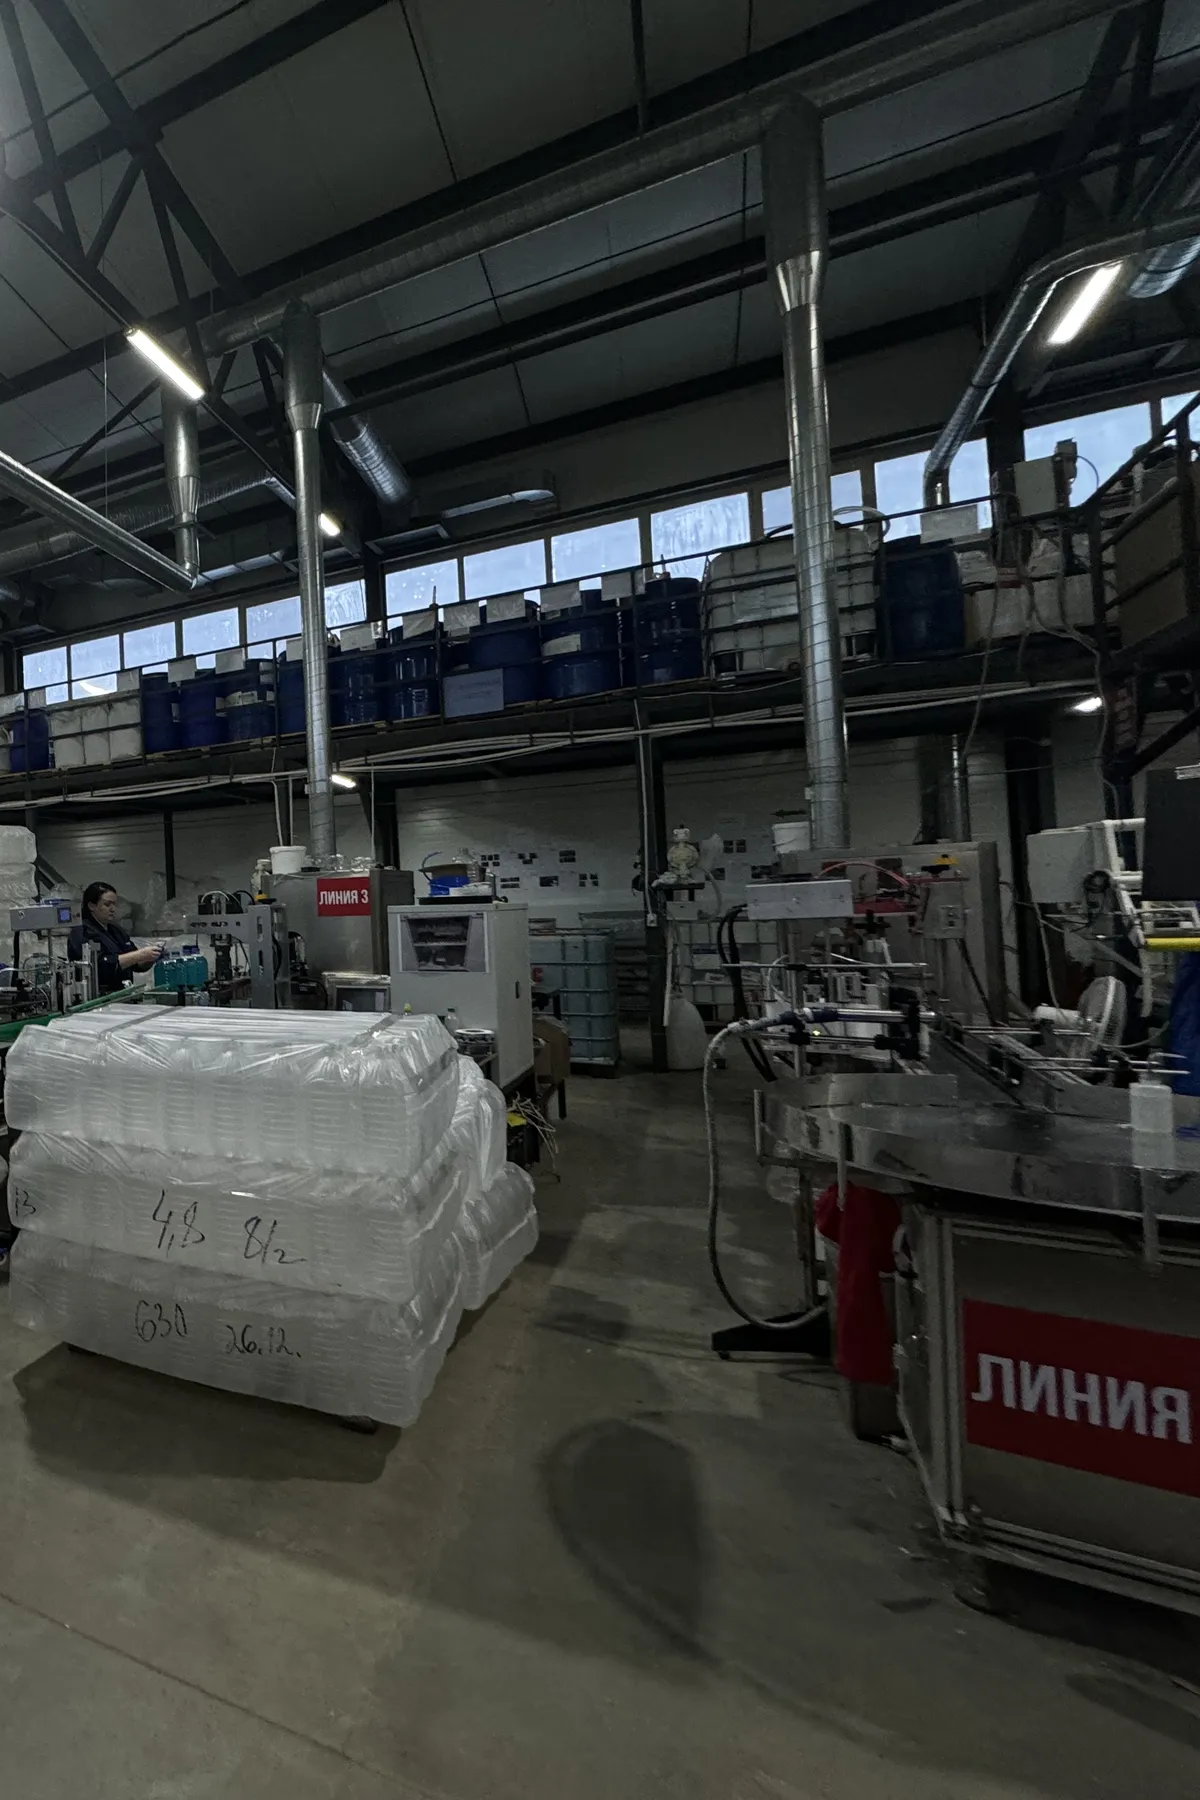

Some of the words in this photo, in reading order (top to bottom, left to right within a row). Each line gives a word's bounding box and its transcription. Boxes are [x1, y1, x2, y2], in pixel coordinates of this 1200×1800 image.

[319, 890, 359, 905] ЛИНИЯ
[361, 889, 369, 904] 3
[971, 1353, 1193, 1444] ЛИНИЯ
